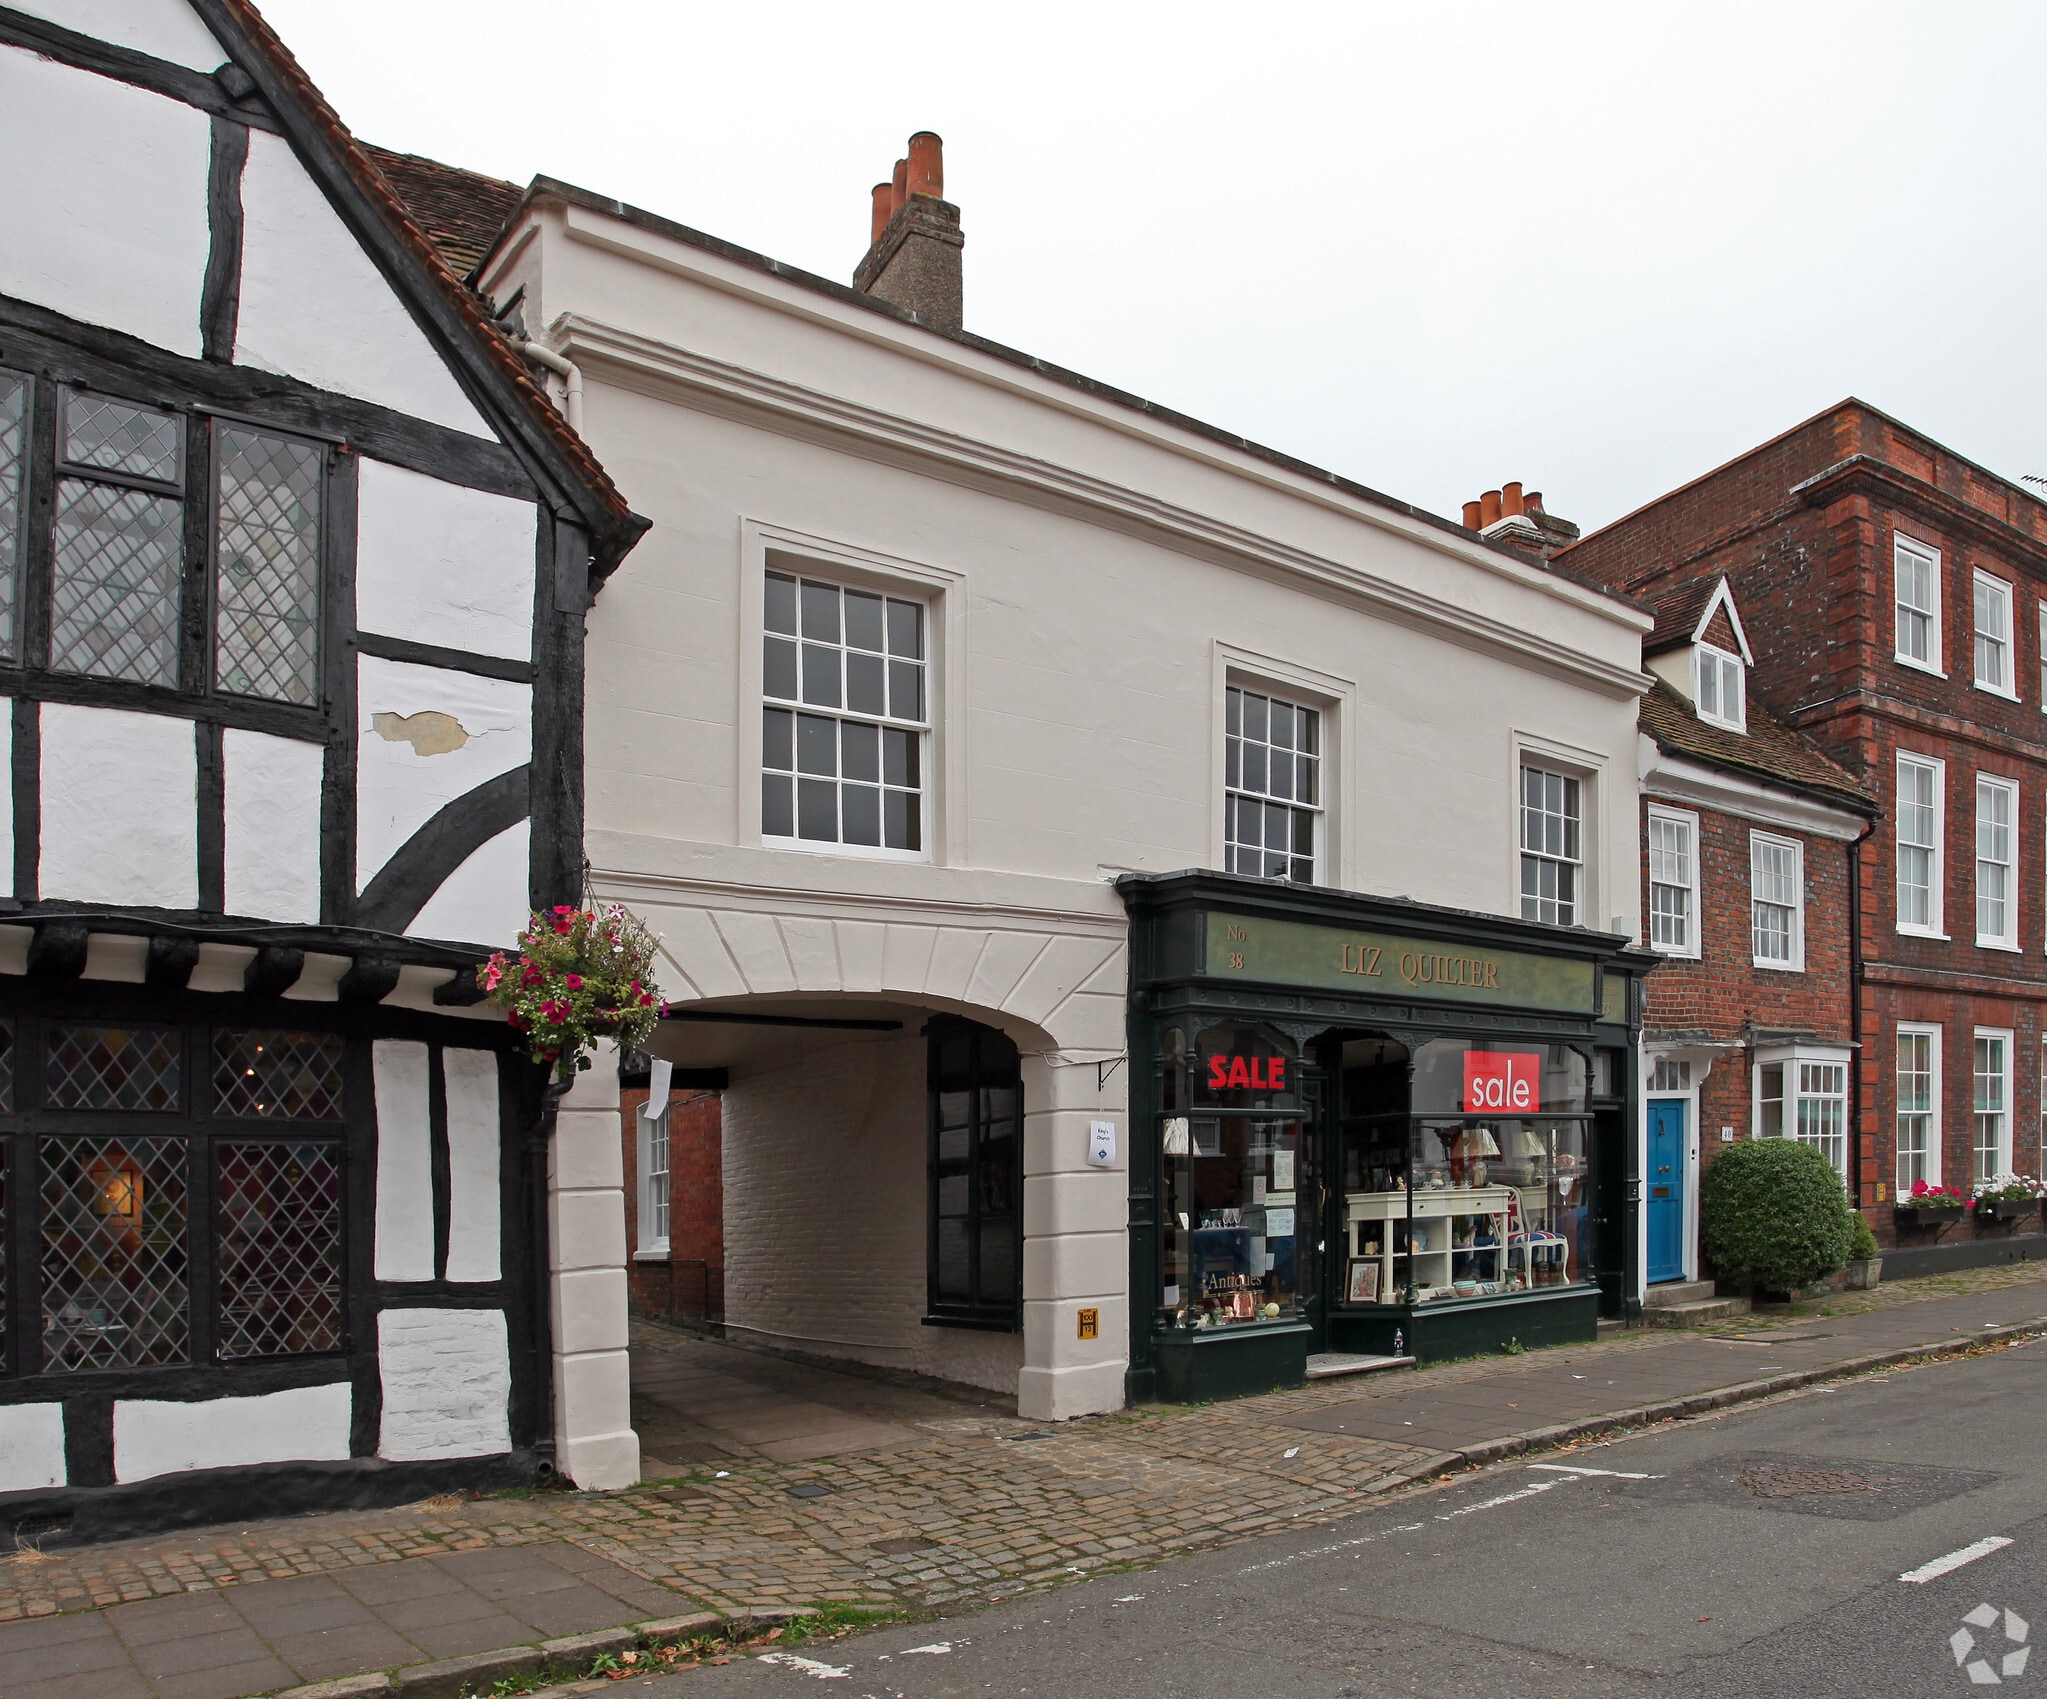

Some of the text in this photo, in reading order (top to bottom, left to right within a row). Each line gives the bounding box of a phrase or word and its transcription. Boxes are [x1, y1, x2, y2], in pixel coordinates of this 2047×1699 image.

[1227, 924, 1247, 942] No
[1228, 952, 1245, 970] 38
[1340, 943, 1499, 988] LIZ QUILTER
[1208, 1055, 1285, 1089] SALE
[1471, 1059, 1530, 1108] sale
[1724, 1129, 1732, 1139] 40
[1208, 1271, 1263, 1291] Antiques
